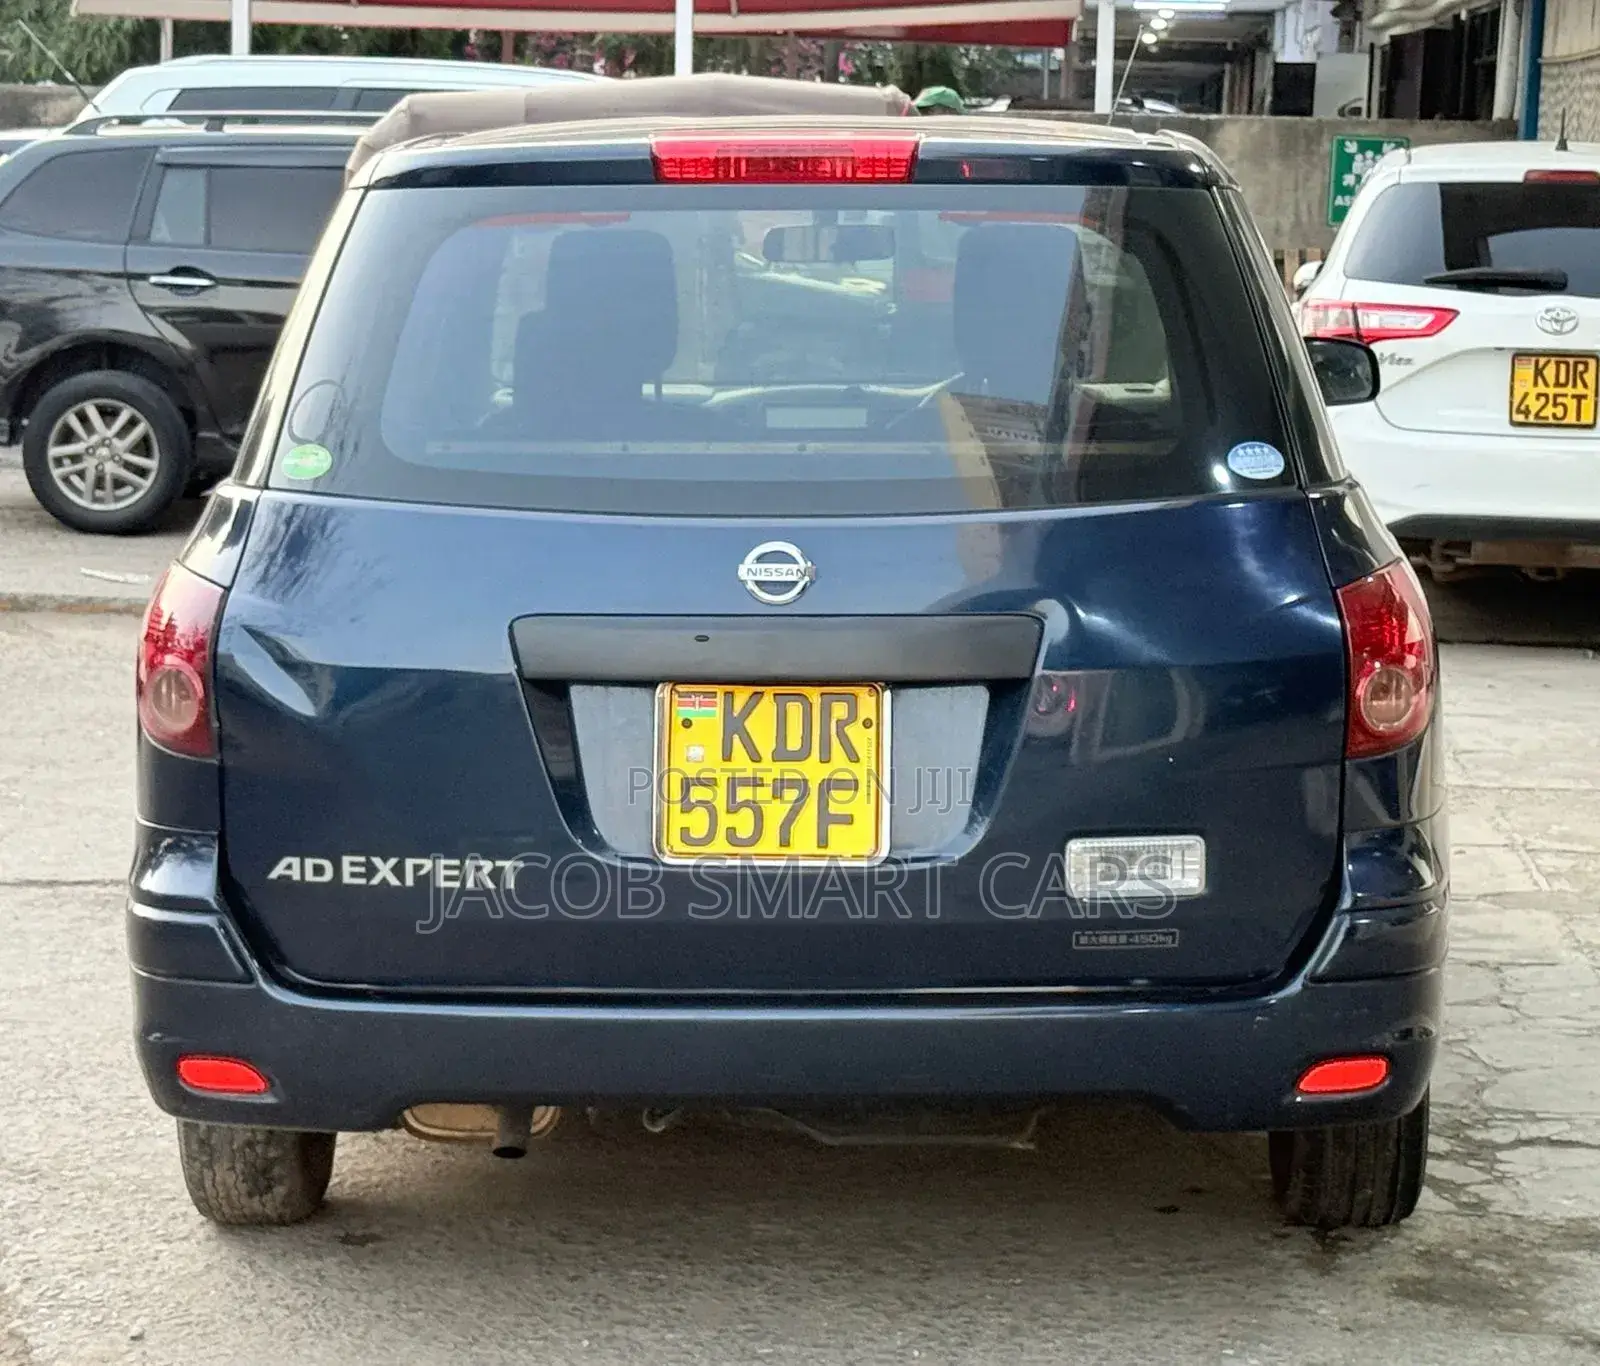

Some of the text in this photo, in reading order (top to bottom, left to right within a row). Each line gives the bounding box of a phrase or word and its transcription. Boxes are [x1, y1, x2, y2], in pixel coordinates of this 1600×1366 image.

[1532, 359, 1589, 389] KDR
[1515, 393, 1588, 422] 425T
[746, 567, 807, 577] NISSAN
[721, 691, 860, 763] KDR
[679, 777, 859, 849] 557F
[266, 856, 526, 890] AD EXPERT
